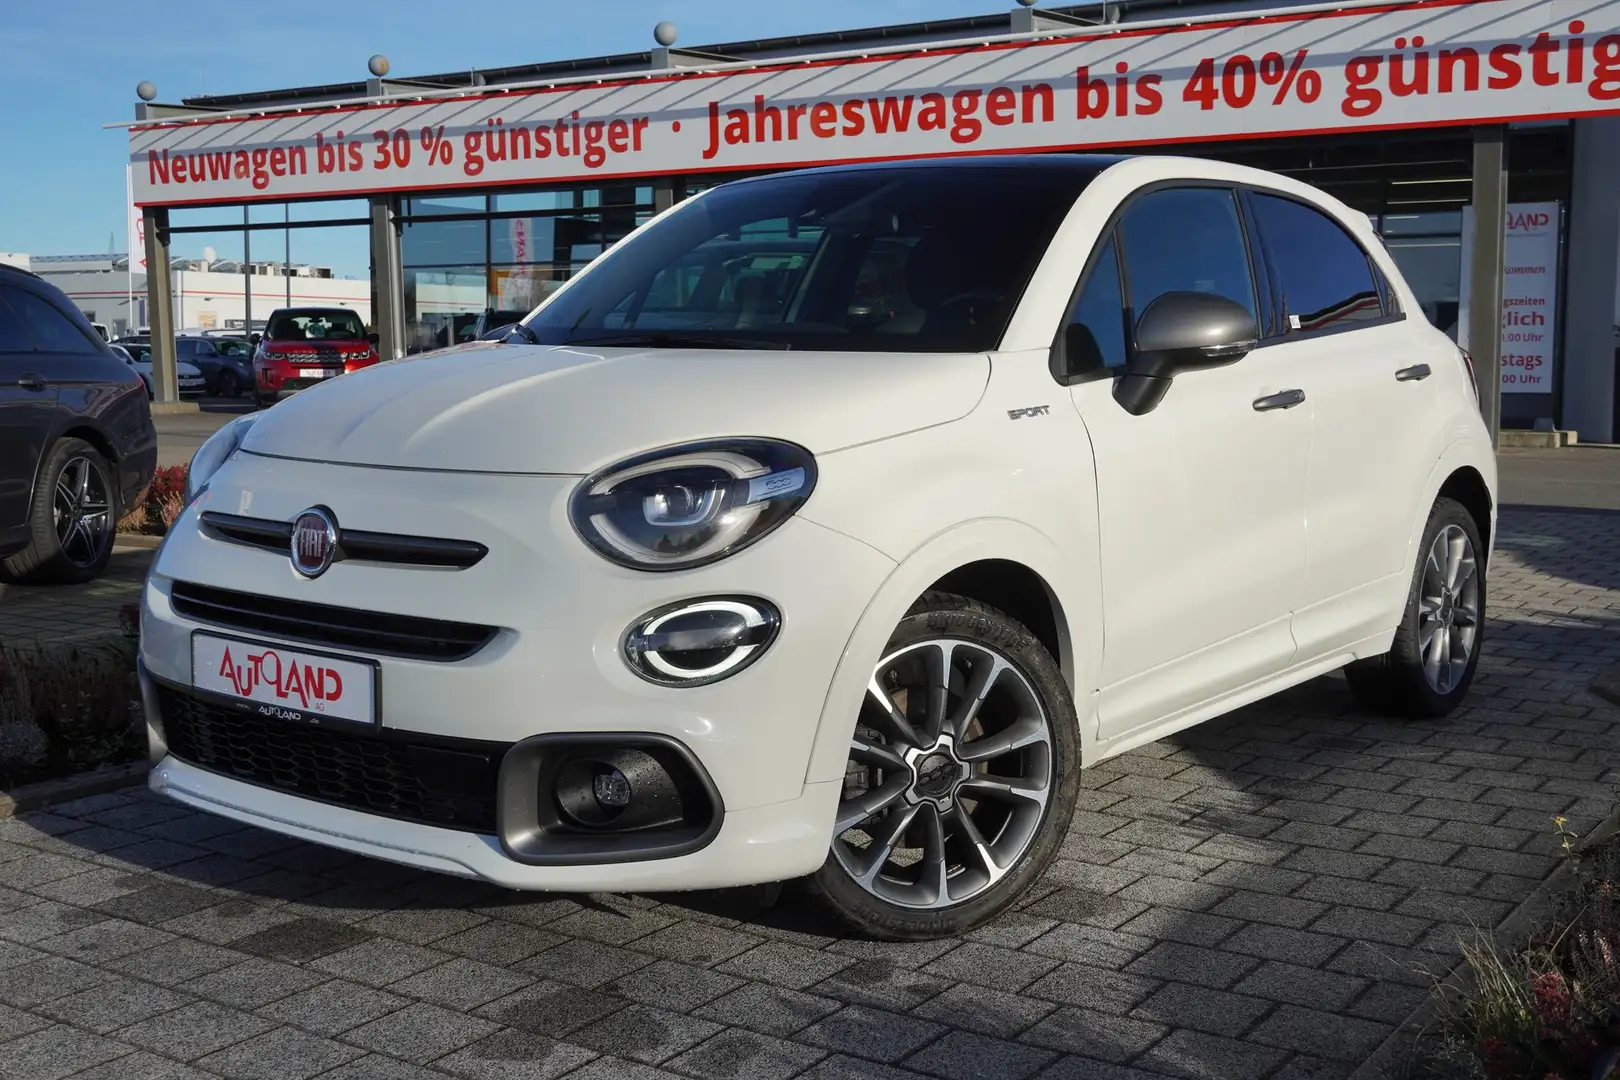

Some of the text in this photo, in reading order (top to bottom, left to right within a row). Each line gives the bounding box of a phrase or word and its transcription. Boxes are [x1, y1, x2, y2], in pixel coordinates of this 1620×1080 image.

[149, 144, 307, 190] Neuwagen
[317, 130, 364, 174] bis
[373, 127, 411, 169] 30
[421, 124, 453, 166] %
[464, 110, 649, 177] günstiger
[702, 80, 1054, 159] Jahreswagen
[1077, 61, 1163, 120] bis
[1183, 48, 1322, 111] 40%
[1507, 211, 1549, 231] LAND
[1523, 332, 1544, 342] Uhr
[1520, 374, 1542, 384] Uhr
[1007, 405, 1050, 420] SPORT
[300, 527, 326, 557] FIAT
[219, 645, 343, 709] AUTOLAND
[258, 705, 301, 720] AUTOLAND
[315, 702, 325, 712] AG
